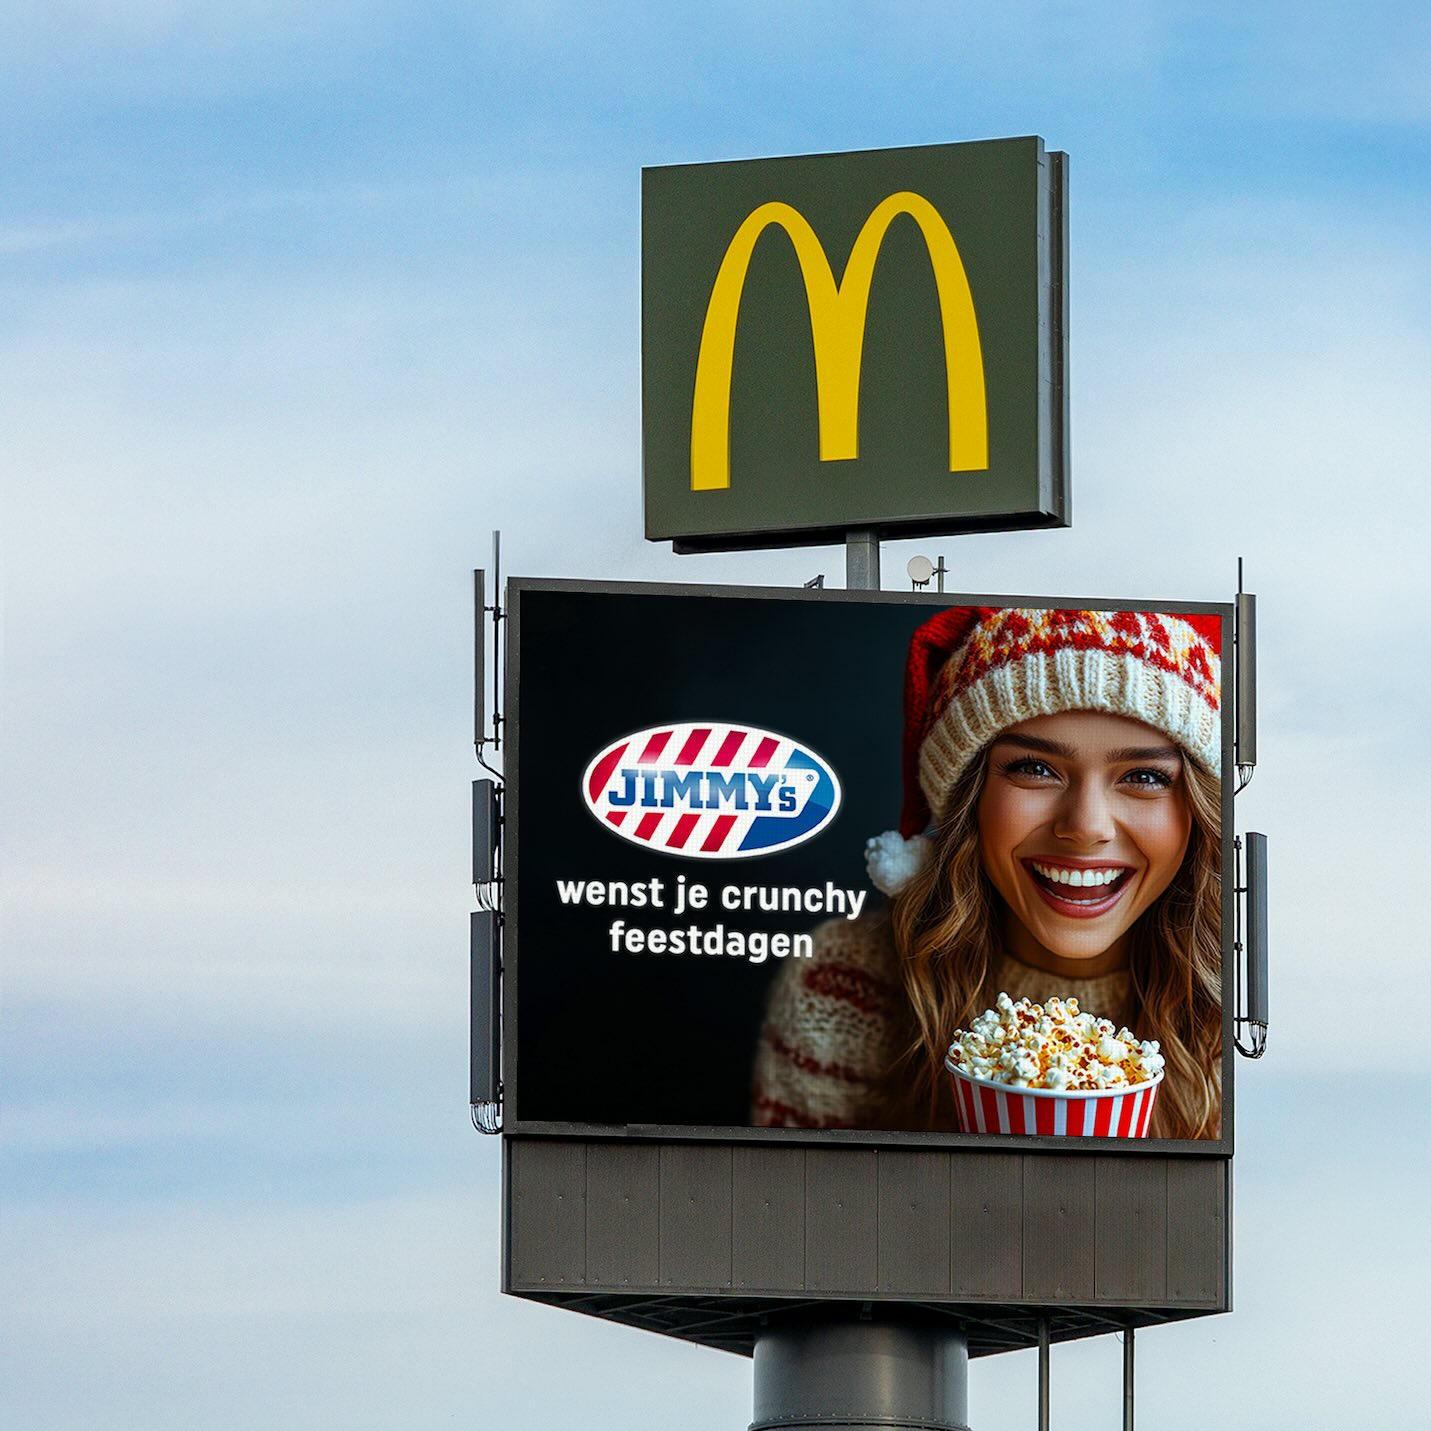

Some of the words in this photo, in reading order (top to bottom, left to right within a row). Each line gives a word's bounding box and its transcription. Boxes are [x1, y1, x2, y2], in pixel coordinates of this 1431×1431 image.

[556, 877, 665, 906] wenst
[673, 874, 709, 915] je
[721, 881, 867, 920] crunchy
[608, 920, 814, 963] feestdagen
